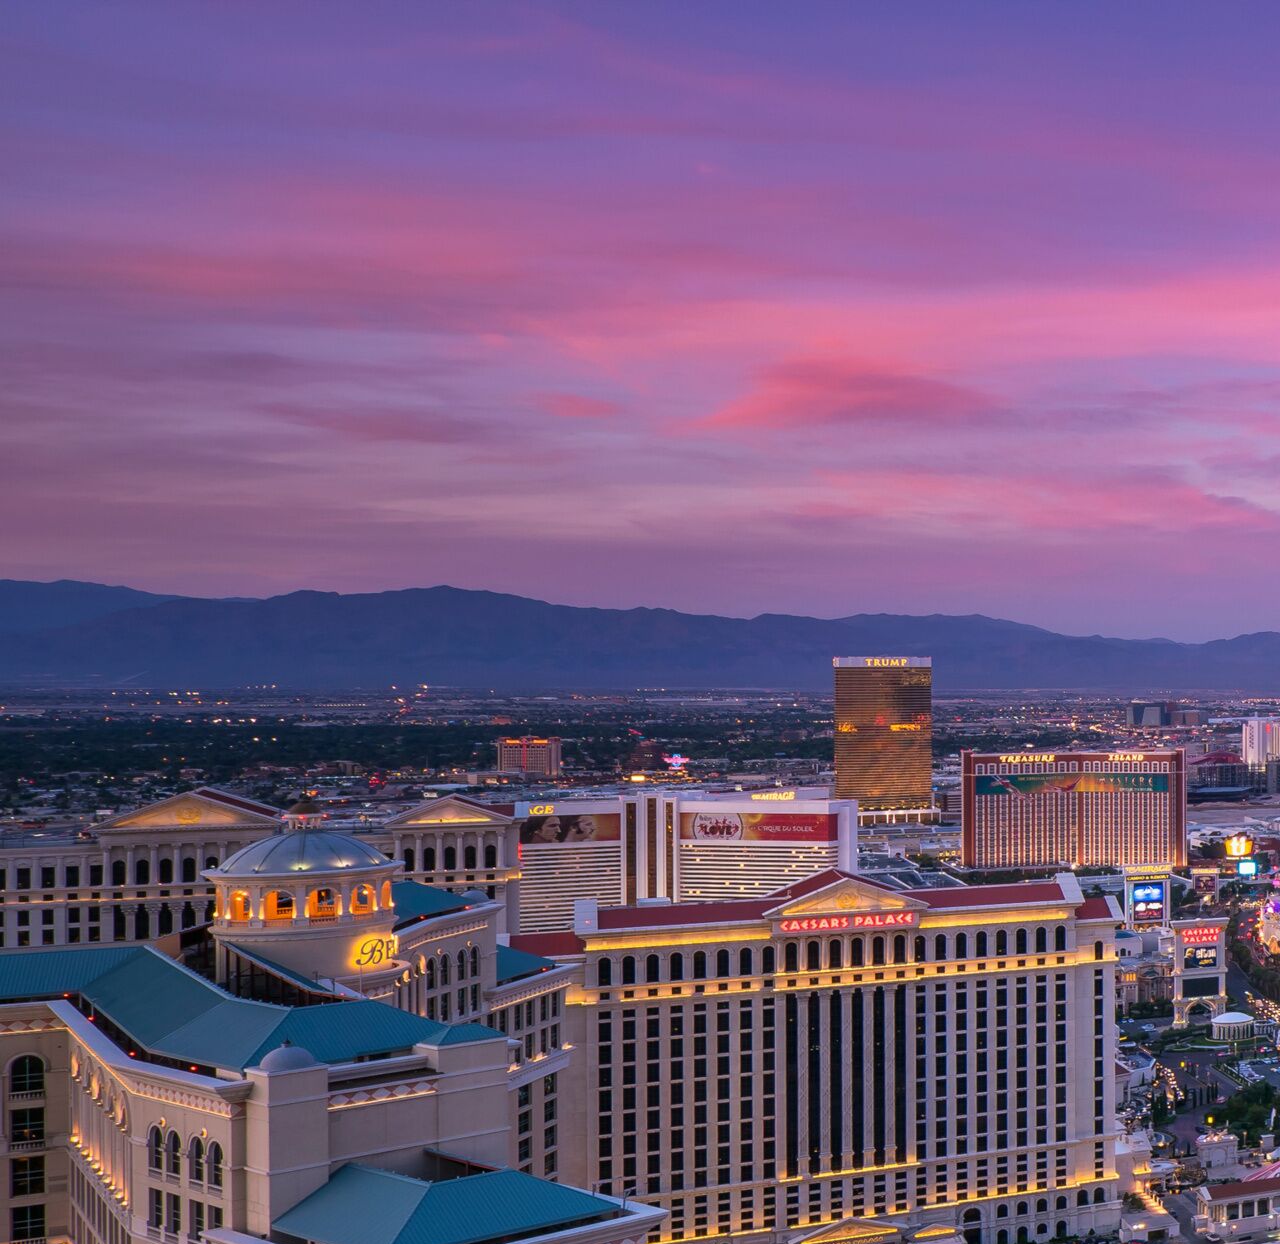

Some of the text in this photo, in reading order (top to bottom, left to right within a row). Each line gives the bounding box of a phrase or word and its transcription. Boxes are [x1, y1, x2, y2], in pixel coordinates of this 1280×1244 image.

[865, 658, 908, 667] TRUMP
[1000, 754, 1144, 763] TREASURE ISLAND
[761, 791, 795, 800] MIRAGE
[780, 911, 914, 931] CAESARS PALACE
[1181, 927, 1221, 936] CAESARS
[1183, 935, 1218, 944] PALACE
